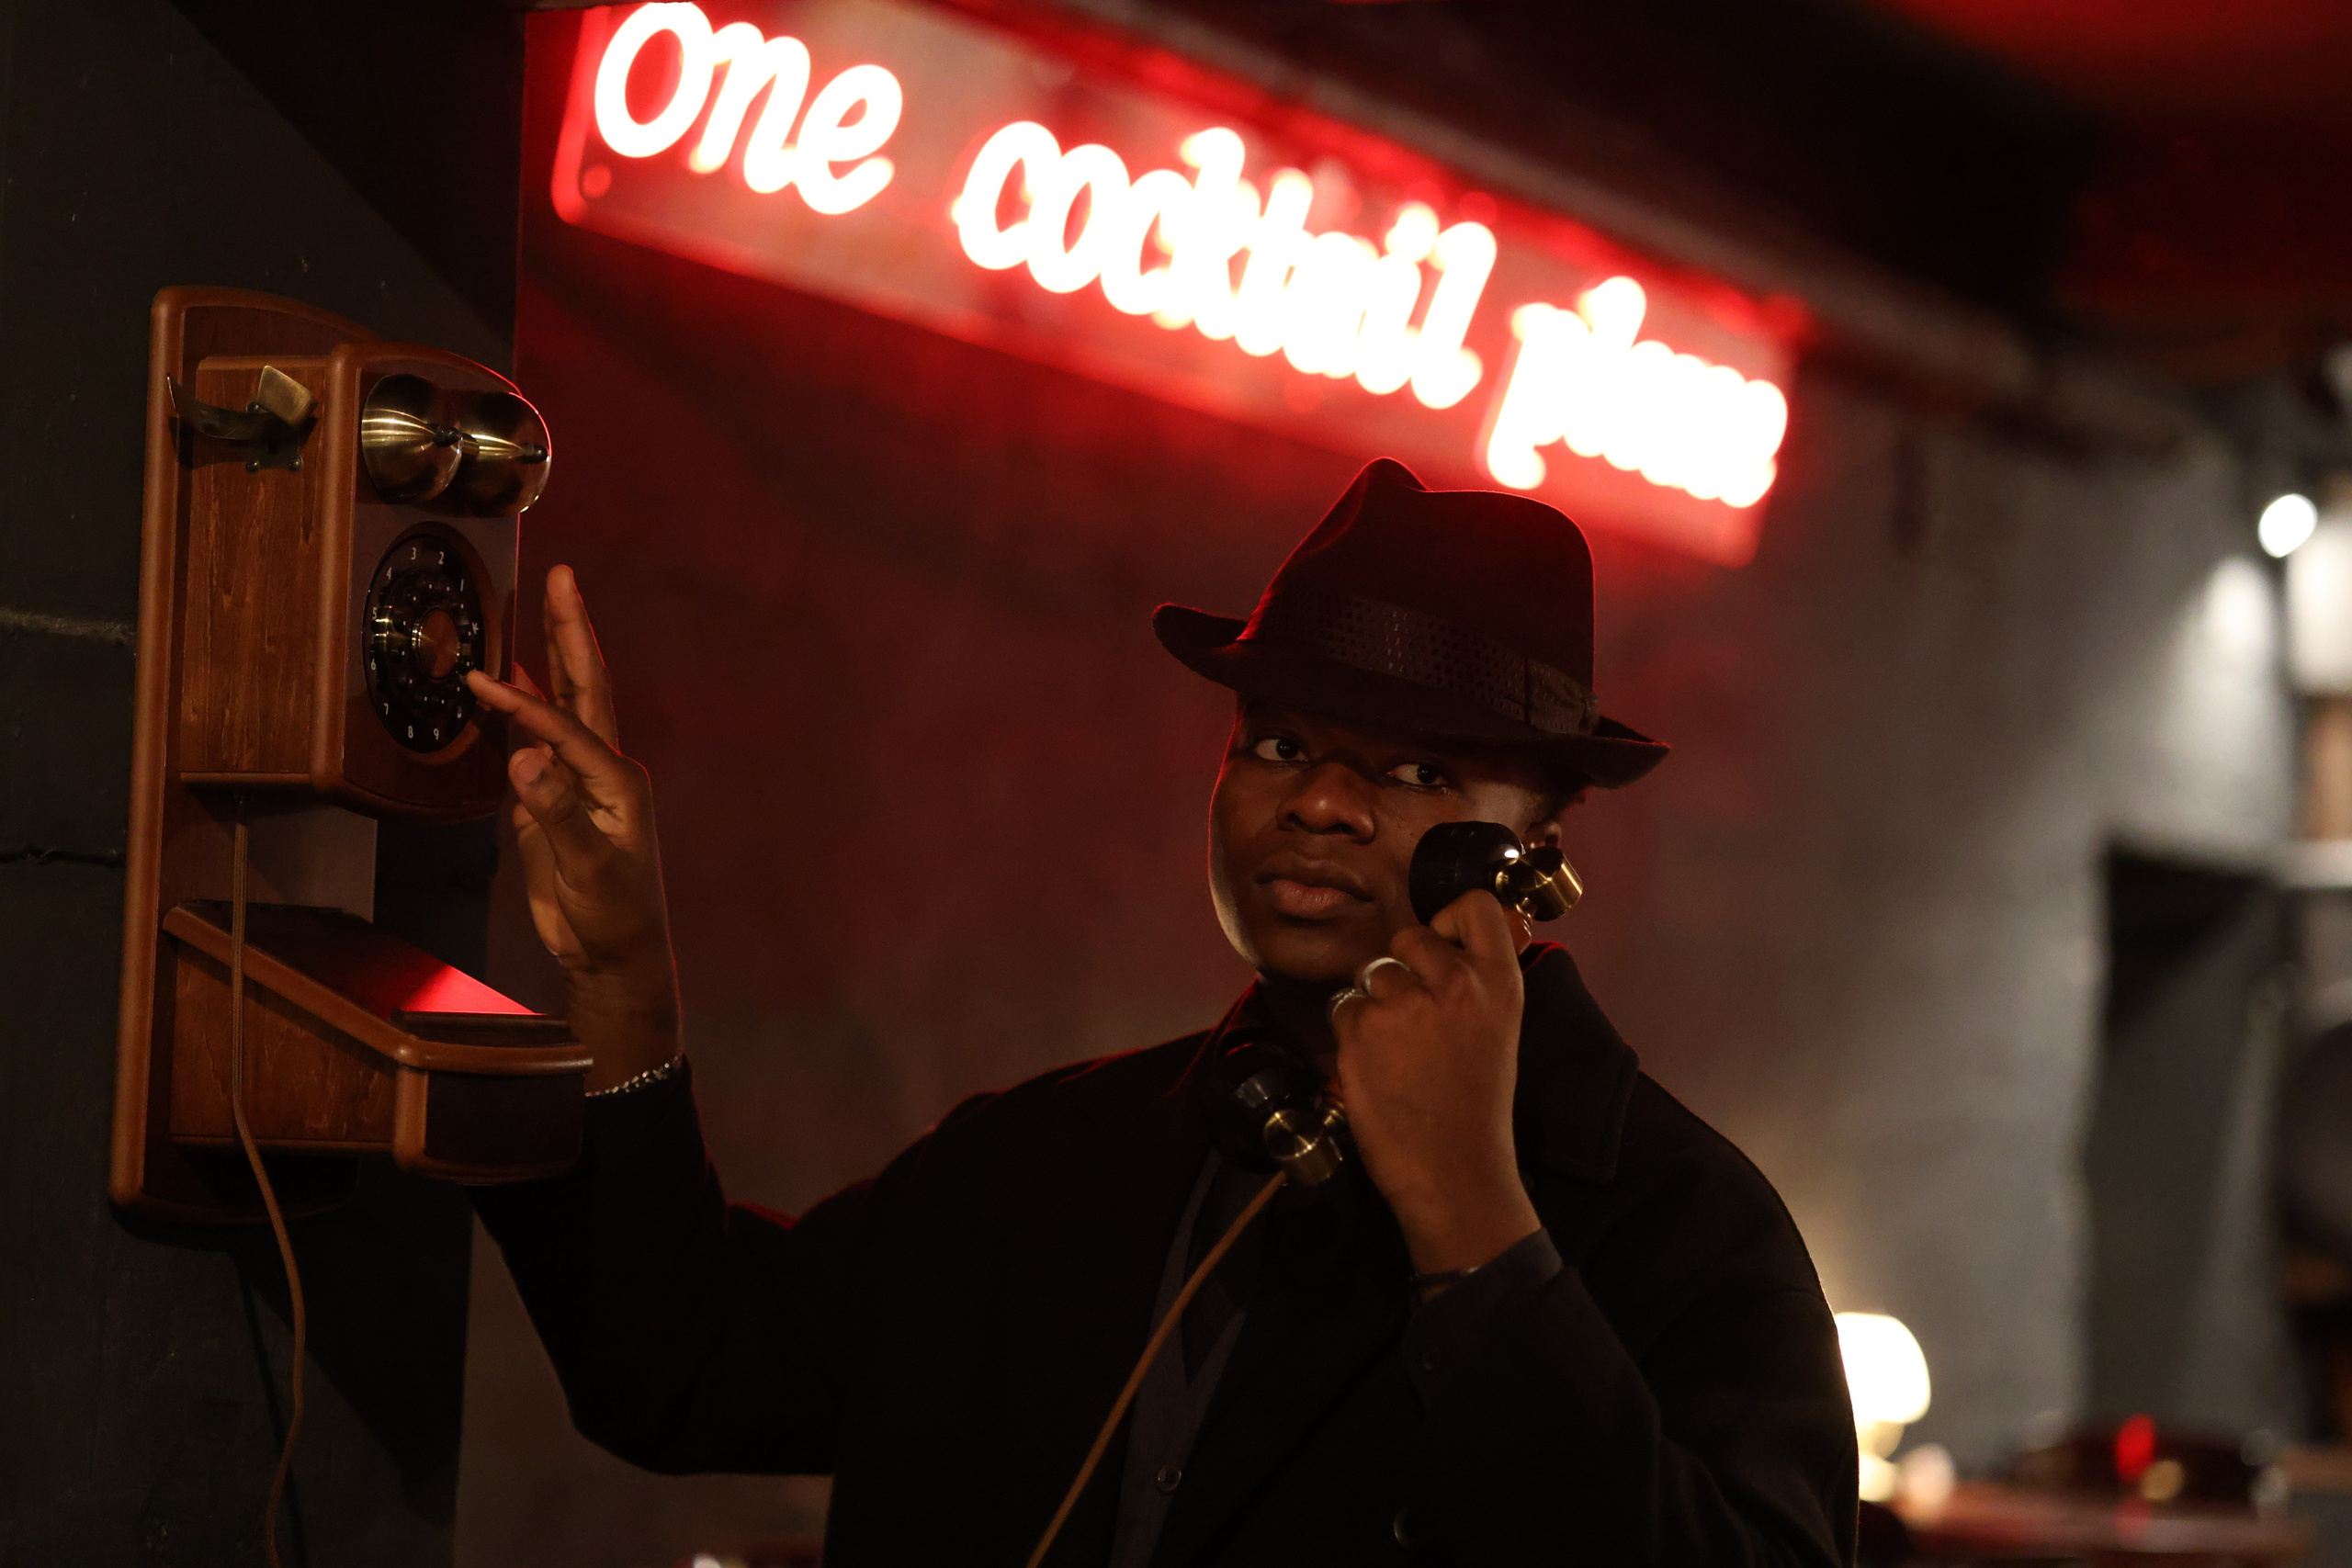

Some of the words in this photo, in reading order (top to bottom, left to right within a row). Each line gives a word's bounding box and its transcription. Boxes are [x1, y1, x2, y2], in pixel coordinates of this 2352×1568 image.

[410, 547, 417, 561] 3
[437, 550, 446, 566] 2
[385, 567, 393, 581] 4
[459, 578, 465, 593] 1
[371, 605, 379, 621] 5
[369, 657, 377, 671] 6
[382, 702, 390, 716] 7
[407, 725, 414, 739] 8
[433, 728, 441, 742] 9
